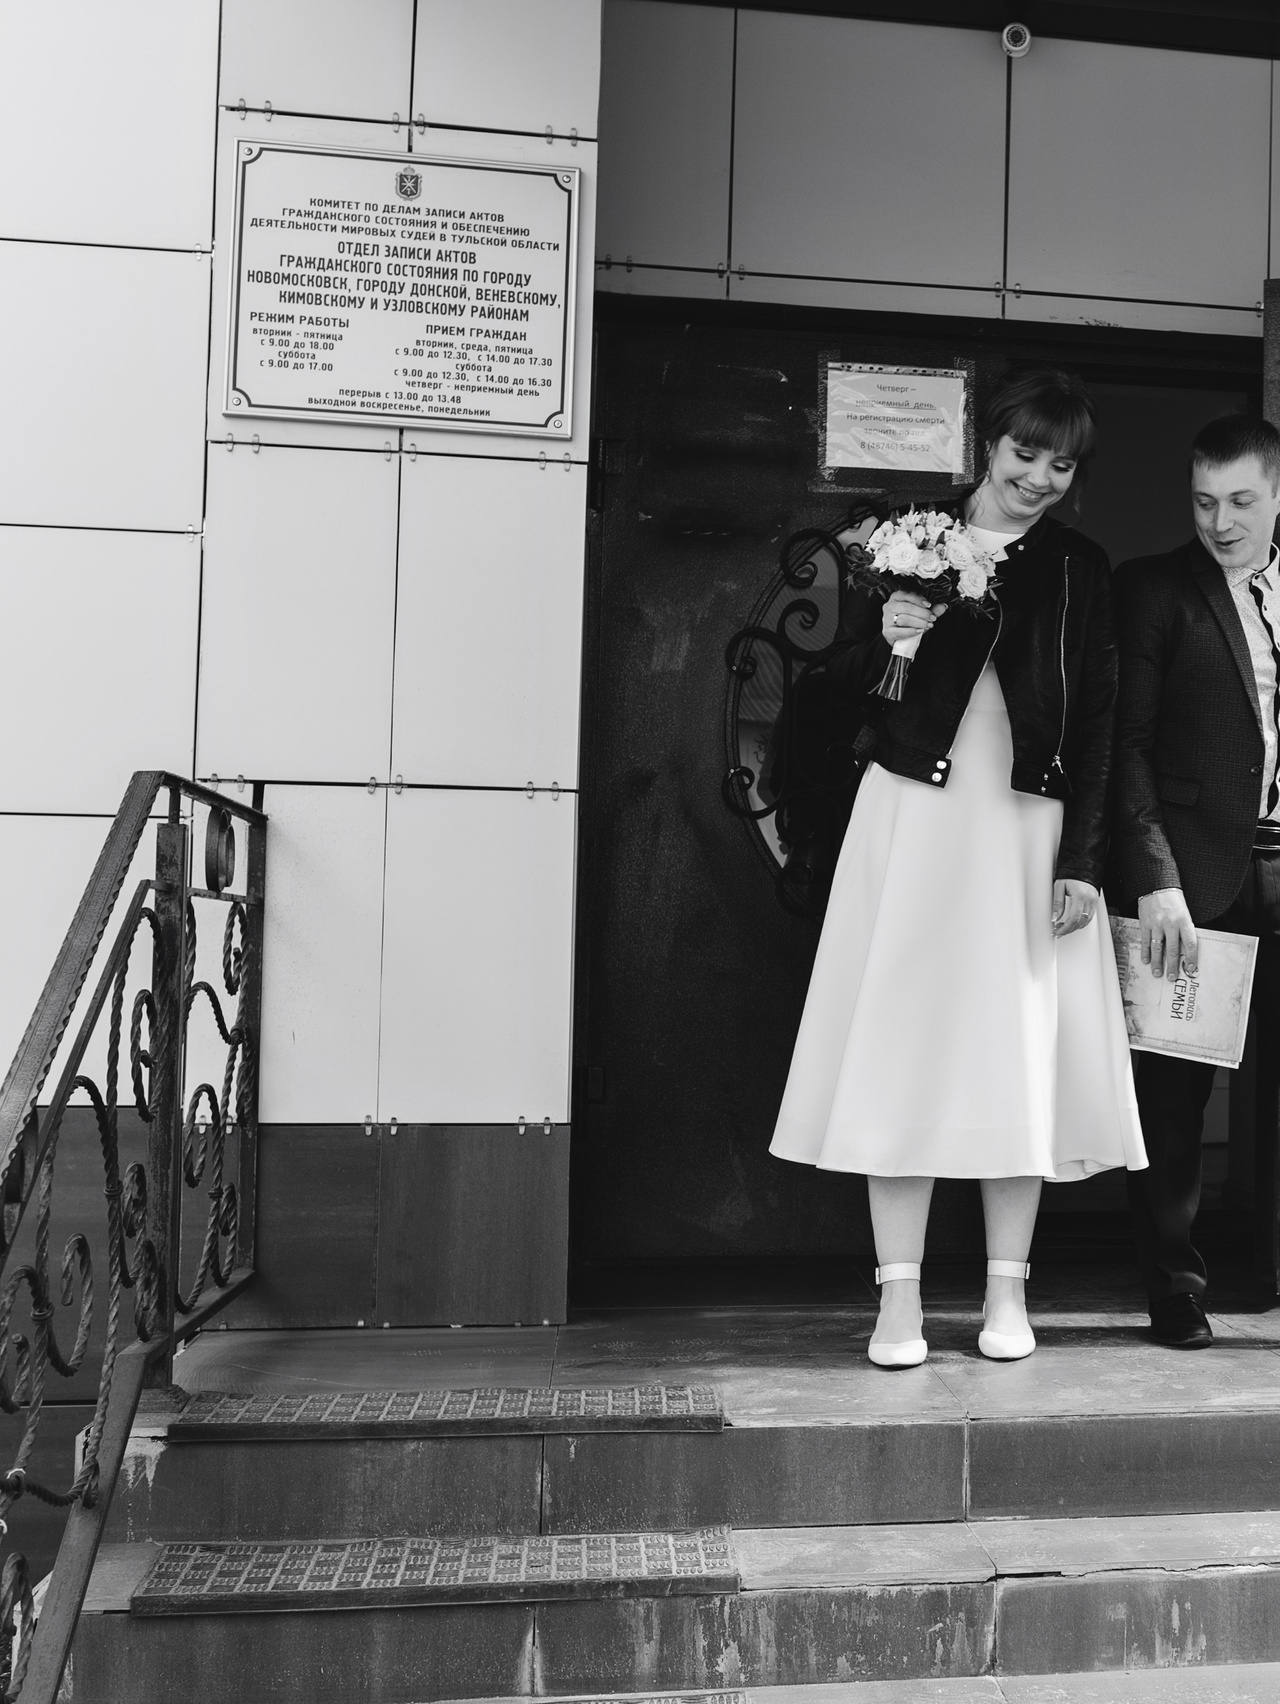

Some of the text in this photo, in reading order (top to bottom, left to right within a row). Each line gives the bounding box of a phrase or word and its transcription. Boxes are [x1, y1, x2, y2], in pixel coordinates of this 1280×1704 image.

[309, 197, 504, 223] КОМИТЕТ ПО ДЕЛАМ ЗАПИСИ АКТОВ
[282, 207, 530, 237] ГРАЖДАНСКОГО СОСТОЯНИЯ И ОБЕСПЕЧЕНИЮ
[249, 217, 560, 251] ДЕЯТЕЛЬНОСТИ МИРОВЫХ СУДЕЙ В ТУЛЬСКОЙ ОБЛАСТИ
[337, 240, 477, 265] ОТДЕЛ ЗАПИСИ АКТОВ
[279, 254, 532, 288] ГРАЖДАНСКОГО СОСТОЯНИЯ ПО ГОРОДУ
[247, 269, 561, 309] НОВОМОСКОВСК, ГОРОДУ ДОНСКОЙ, ВЕНЕВСКОМУ,
[278, 290, 529, 322] КИМОВСКОМУ И УЗЛОВСКОМУ РАЙОНАМ
[249, 311, 349, 328] РЕЖИМ РАБОТЫ
[252, 327, 292, 337] вторник
[303, 331, 343, 342] пятница
[425, 324, 527, 342] ПРИЕМ ГРАЖДАН
[260, 337, 334, 351] с 9.00 до 18.00
[415, 339, 533, 356] вторник, среда, пятница
[277, 350, 316, 360] суббота
[403, 347, 424, 357] 9.00
[426, 350, 439, 359] до
[442, 350, 470, 361] 12.30,
[477, 354, 482, 362] с
[485, 353, 510, 363] 14.00
[512, 357, 525, 365] до
[528, 356, 552, 367] 17.30
[259, 358, 333, 372] с 9.00 до 17.00
[455, 362, 492, 373] суббота
[393, 368, 398, 376] с
[402, 367, 423, 378] 9.00
[425, 371, 438, 379] до
[441, 371, 469, 382] 12.30,
[485, 374, 509, 384] 14.00
[511, 377, 524, 386] до
[527, 377, 552, 387] 16.30
[338, 388, 461, 404] перерыв с 13.00 до 13.48
[405, 380, 443, 390] четверг
[453, 383, 514, 395] неприемный
[516, 388, 540, 397] день
[876, 384, 909, 394] Четверг
[307, 397, 490, 416] выходной воскресенье, понедельник
[855, 400, 937, 410] неприемный день.
[846, 412, 945, 425] На регистрацию смерти
[864, 427, 897, 436] звоните
[860, 441, 931, 452] 8 (48746) 5-45-52
[1170, 978, 1188, 1020] СЕМЬИ
[1186, 979, 1200, 1022] Летопись
